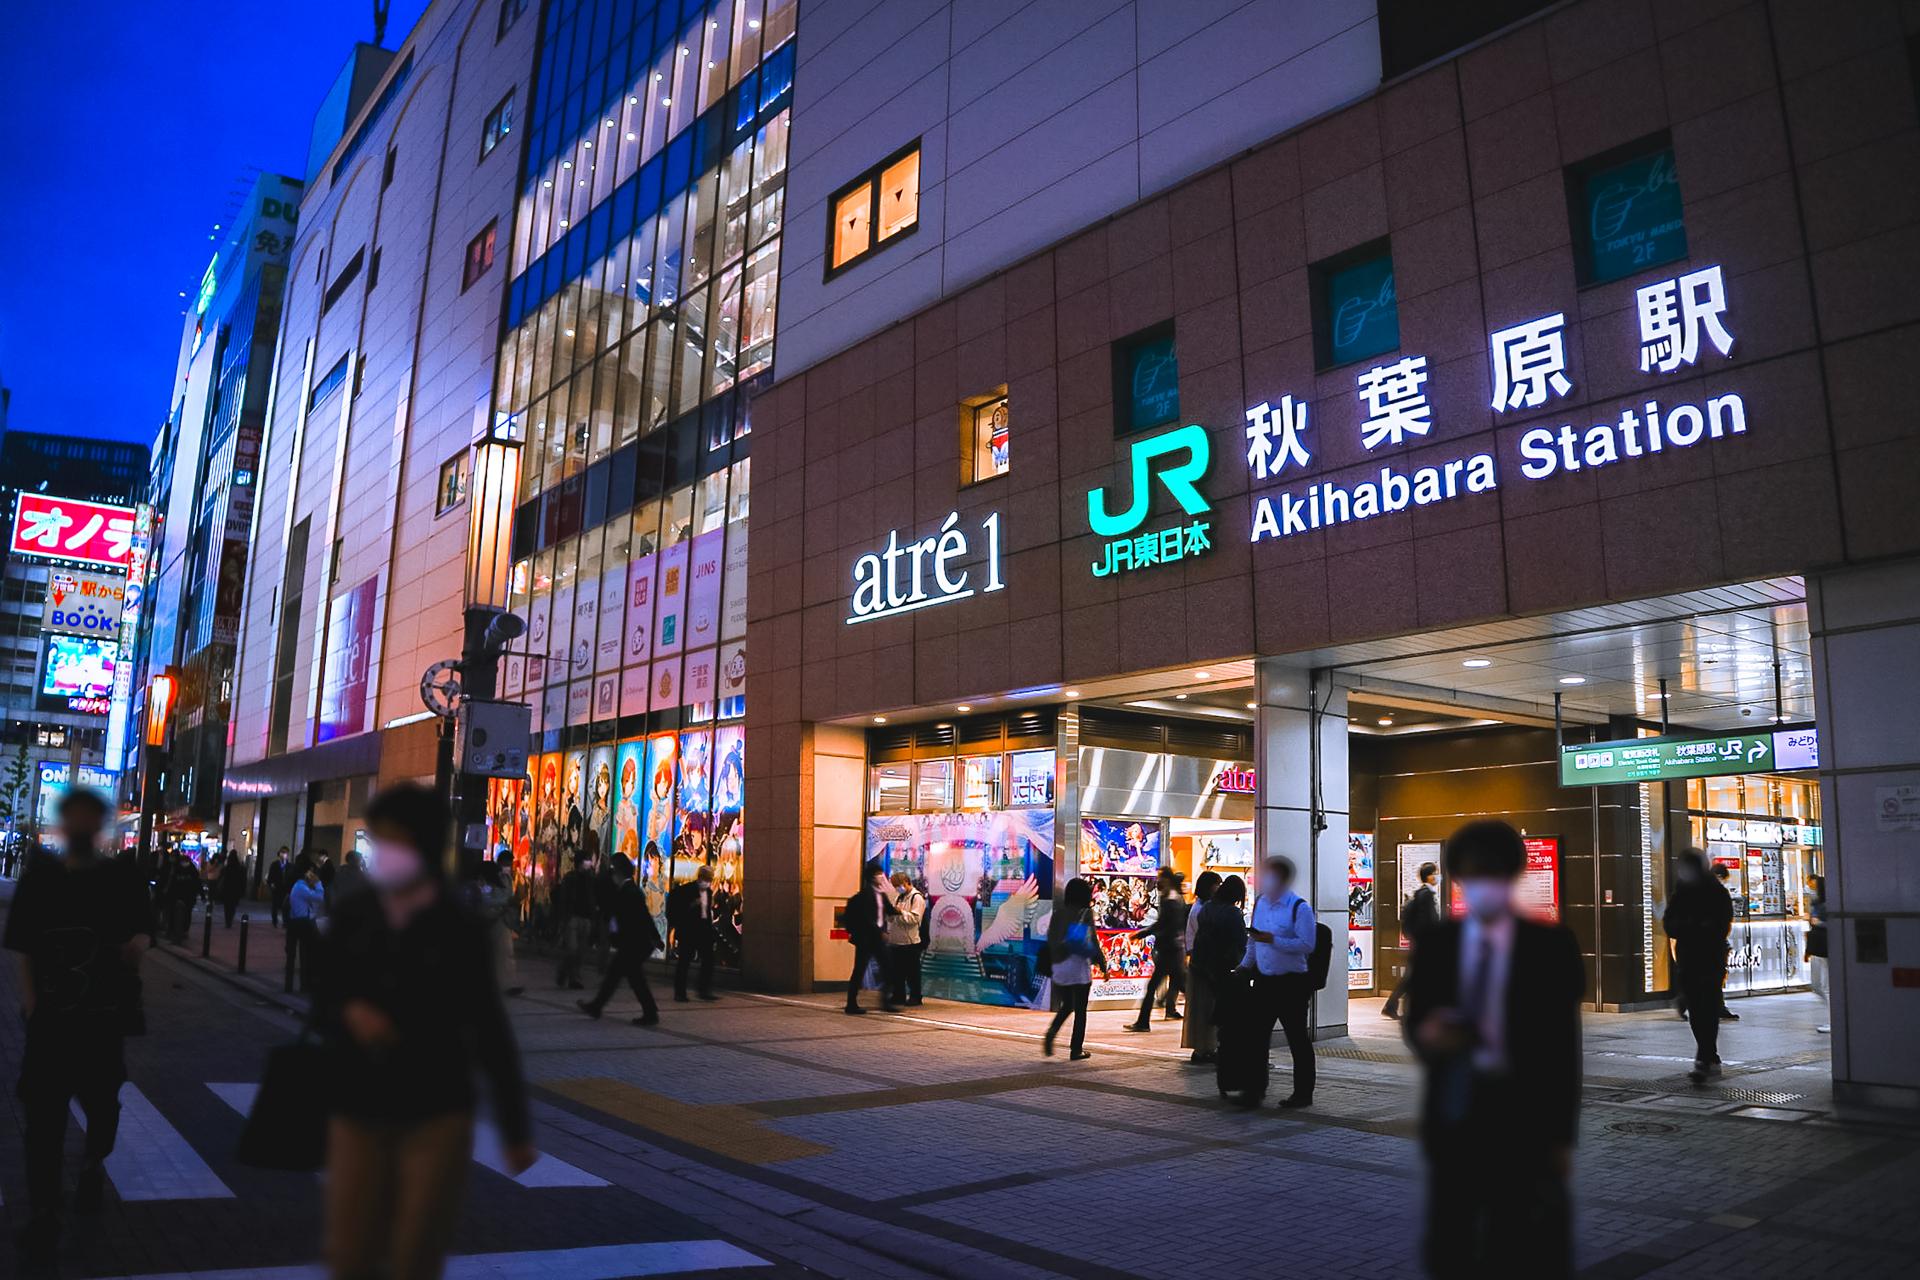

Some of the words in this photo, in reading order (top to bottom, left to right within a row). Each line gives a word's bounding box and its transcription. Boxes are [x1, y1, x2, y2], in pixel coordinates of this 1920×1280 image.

[1632, 241, 1656, 264] 2F
[1245, 265, 1735, 480] 秋葉原駅
[1088, 424, 1211, 536] JR
[1250, 450, 1497, 543] Akihabara
[1520, 391, 1747, 480] Station
[695, 559, 716, 579] JINS
[852, 511, 967, 618] atré
[982, 511, 1005, 593] 1
[1092, 520, 1211, 578] JR東日本
[1664, 757, 1695, 766] Akihabara
[1696, 755, 1717, 763] Station
[1718, 739, 1743, 755] JR
